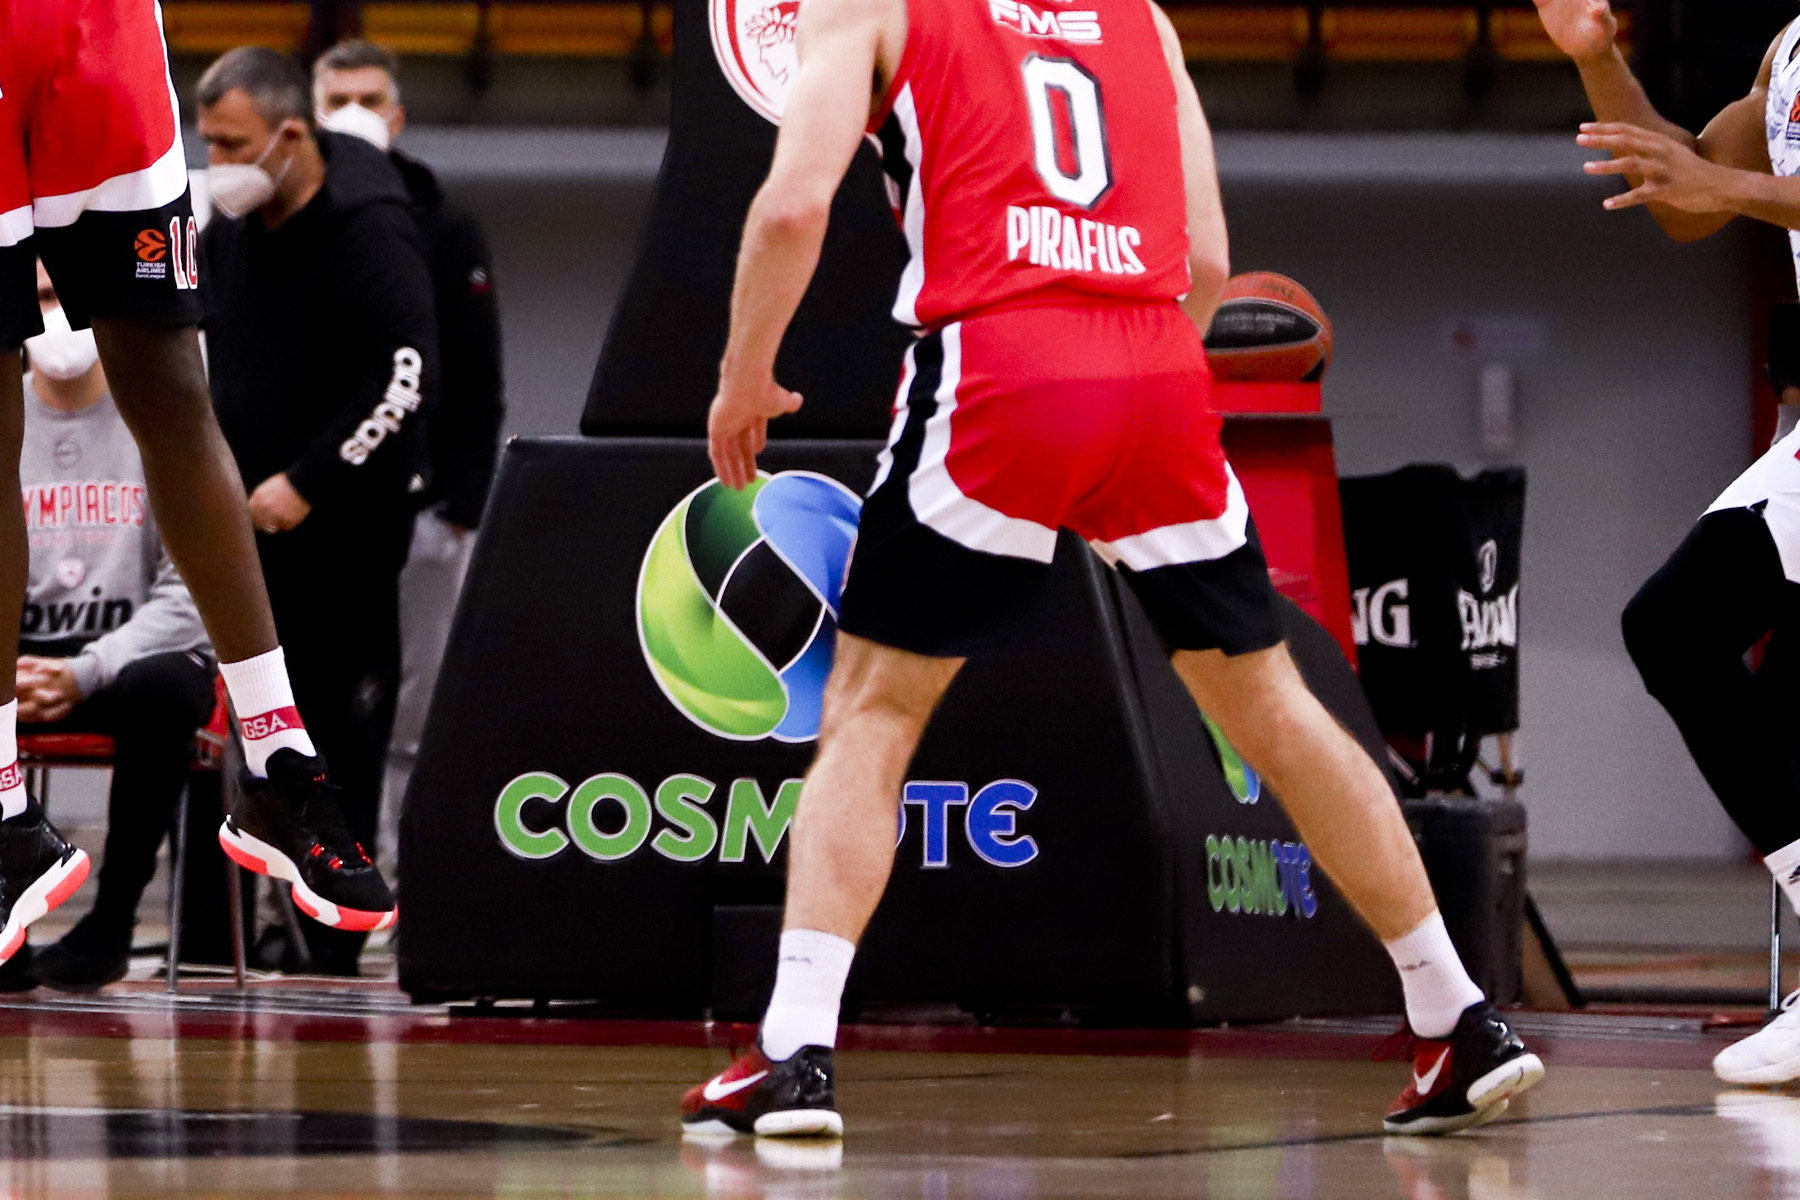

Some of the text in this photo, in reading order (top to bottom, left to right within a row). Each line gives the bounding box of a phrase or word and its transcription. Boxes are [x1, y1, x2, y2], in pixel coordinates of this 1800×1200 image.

[1020, 51, 1115, 211] 0
[340, 346, 422, 466] adidas
[21, 483, 147, 527] YMPIACOS
[242, 711, 288, 739] GSA
[494, 770, 1040, 868] COSMTE
[1205, 833, 1318, 919] COSMOTE
